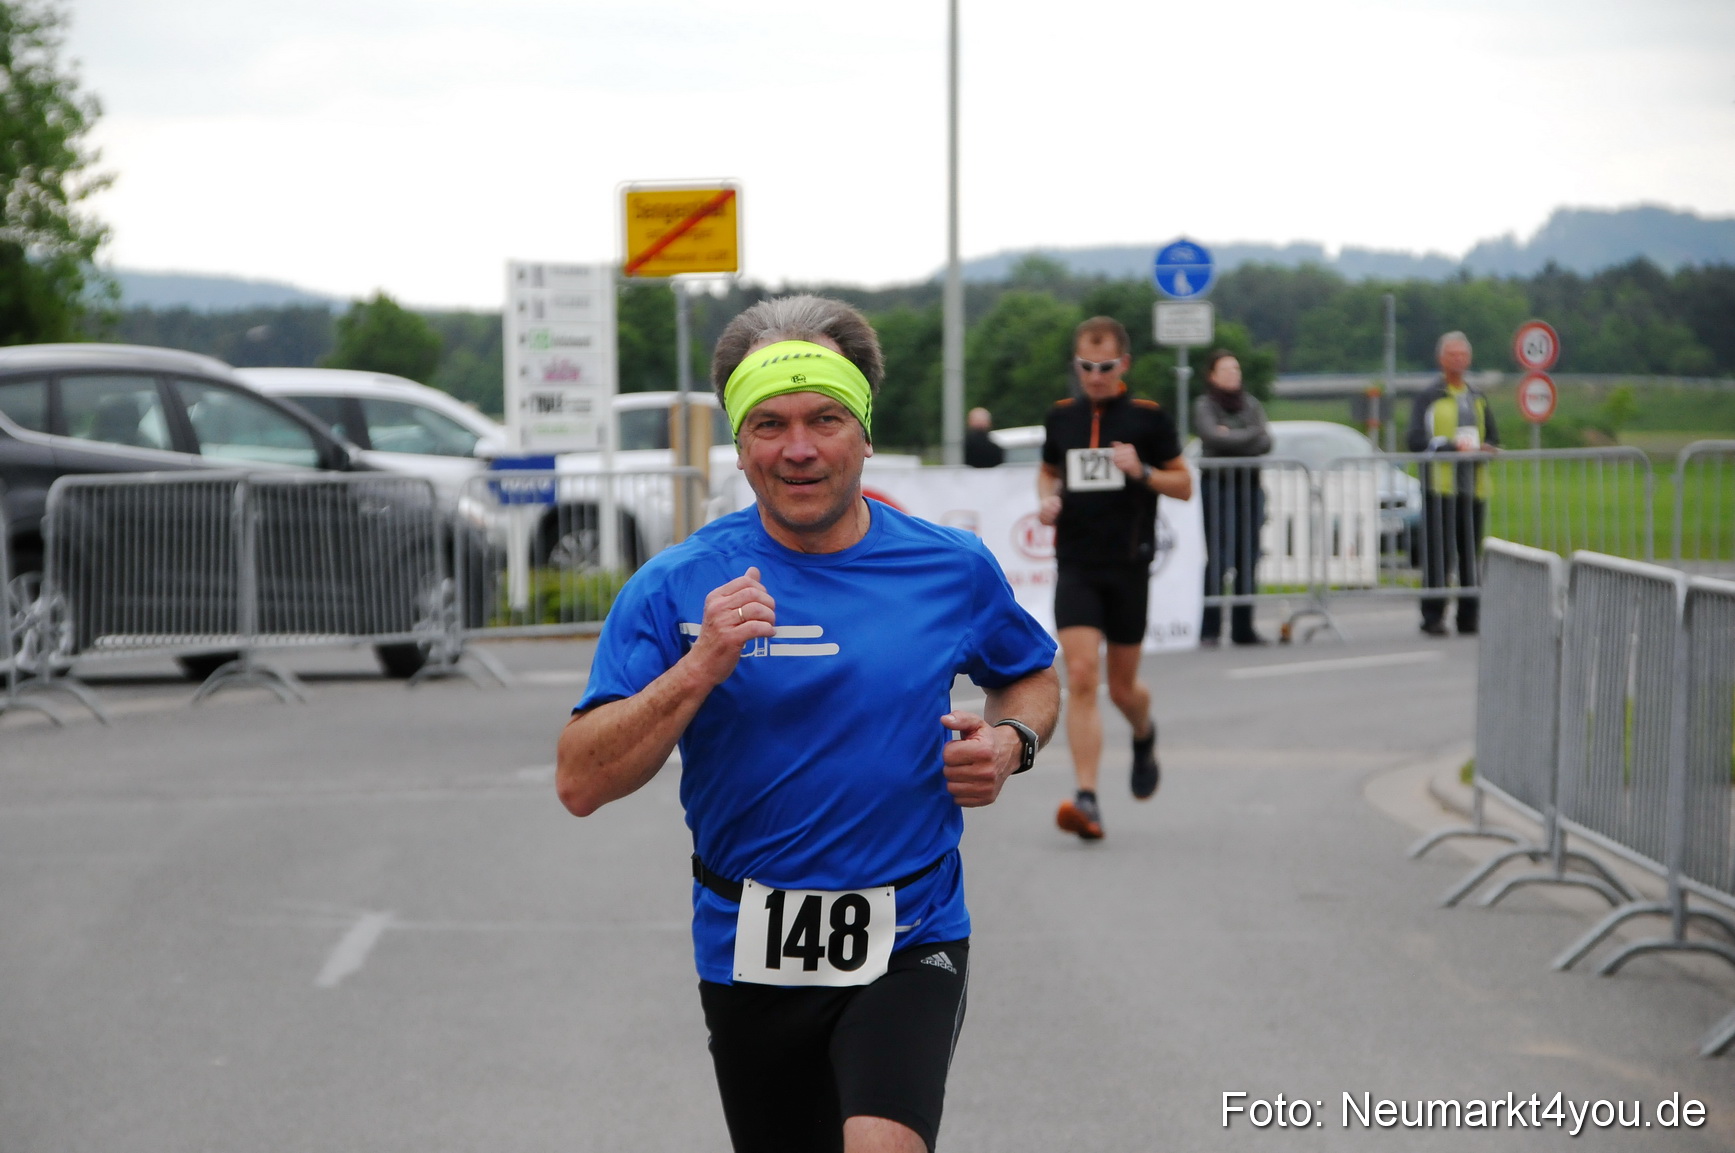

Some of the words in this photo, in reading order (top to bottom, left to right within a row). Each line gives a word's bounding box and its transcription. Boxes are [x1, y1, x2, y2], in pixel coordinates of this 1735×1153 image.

[1080, 451, 1111, 480] 121
[765, 889, 871, 972] 148
[920, 959, 957, 975] adidas
